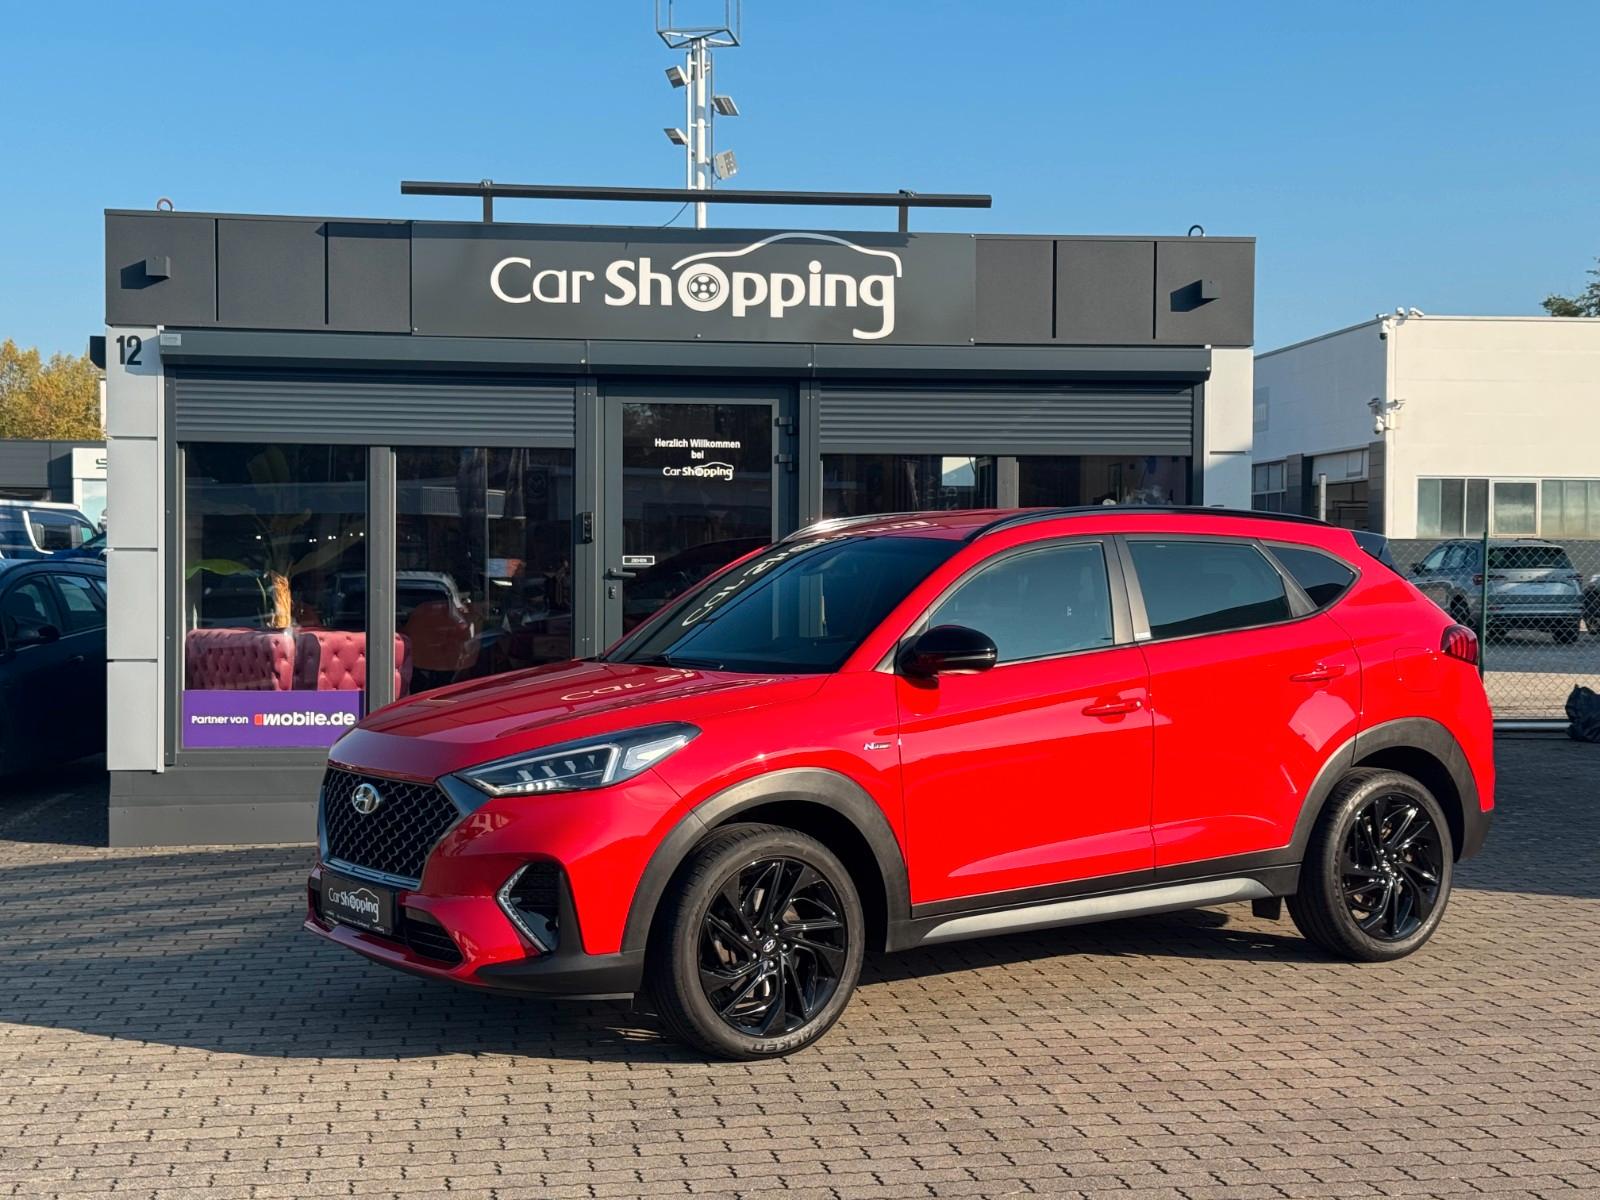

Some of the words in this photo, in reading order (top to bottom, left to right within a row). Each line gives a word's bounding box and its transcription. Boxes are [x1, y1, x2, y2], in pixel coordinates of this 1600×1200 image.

[489, 256, 595, 304] Car
[604, 256, 895, 340] Shopping
[116, 334, 142, 366] 12
[654, 437, 689, 447] Herzlich
[690, 438, 741, 449] Willkommen
[690, 449, 704, 459] bei
[662, 466, 682, 476] Car
[682, 465, 733, 481] Shopping
[191, 715, 229, 724] Partner
[229, 716, 249, 724] von
[262, 711, 356, 726] mobile.de
[340, 891, 379, 923] Shopping
